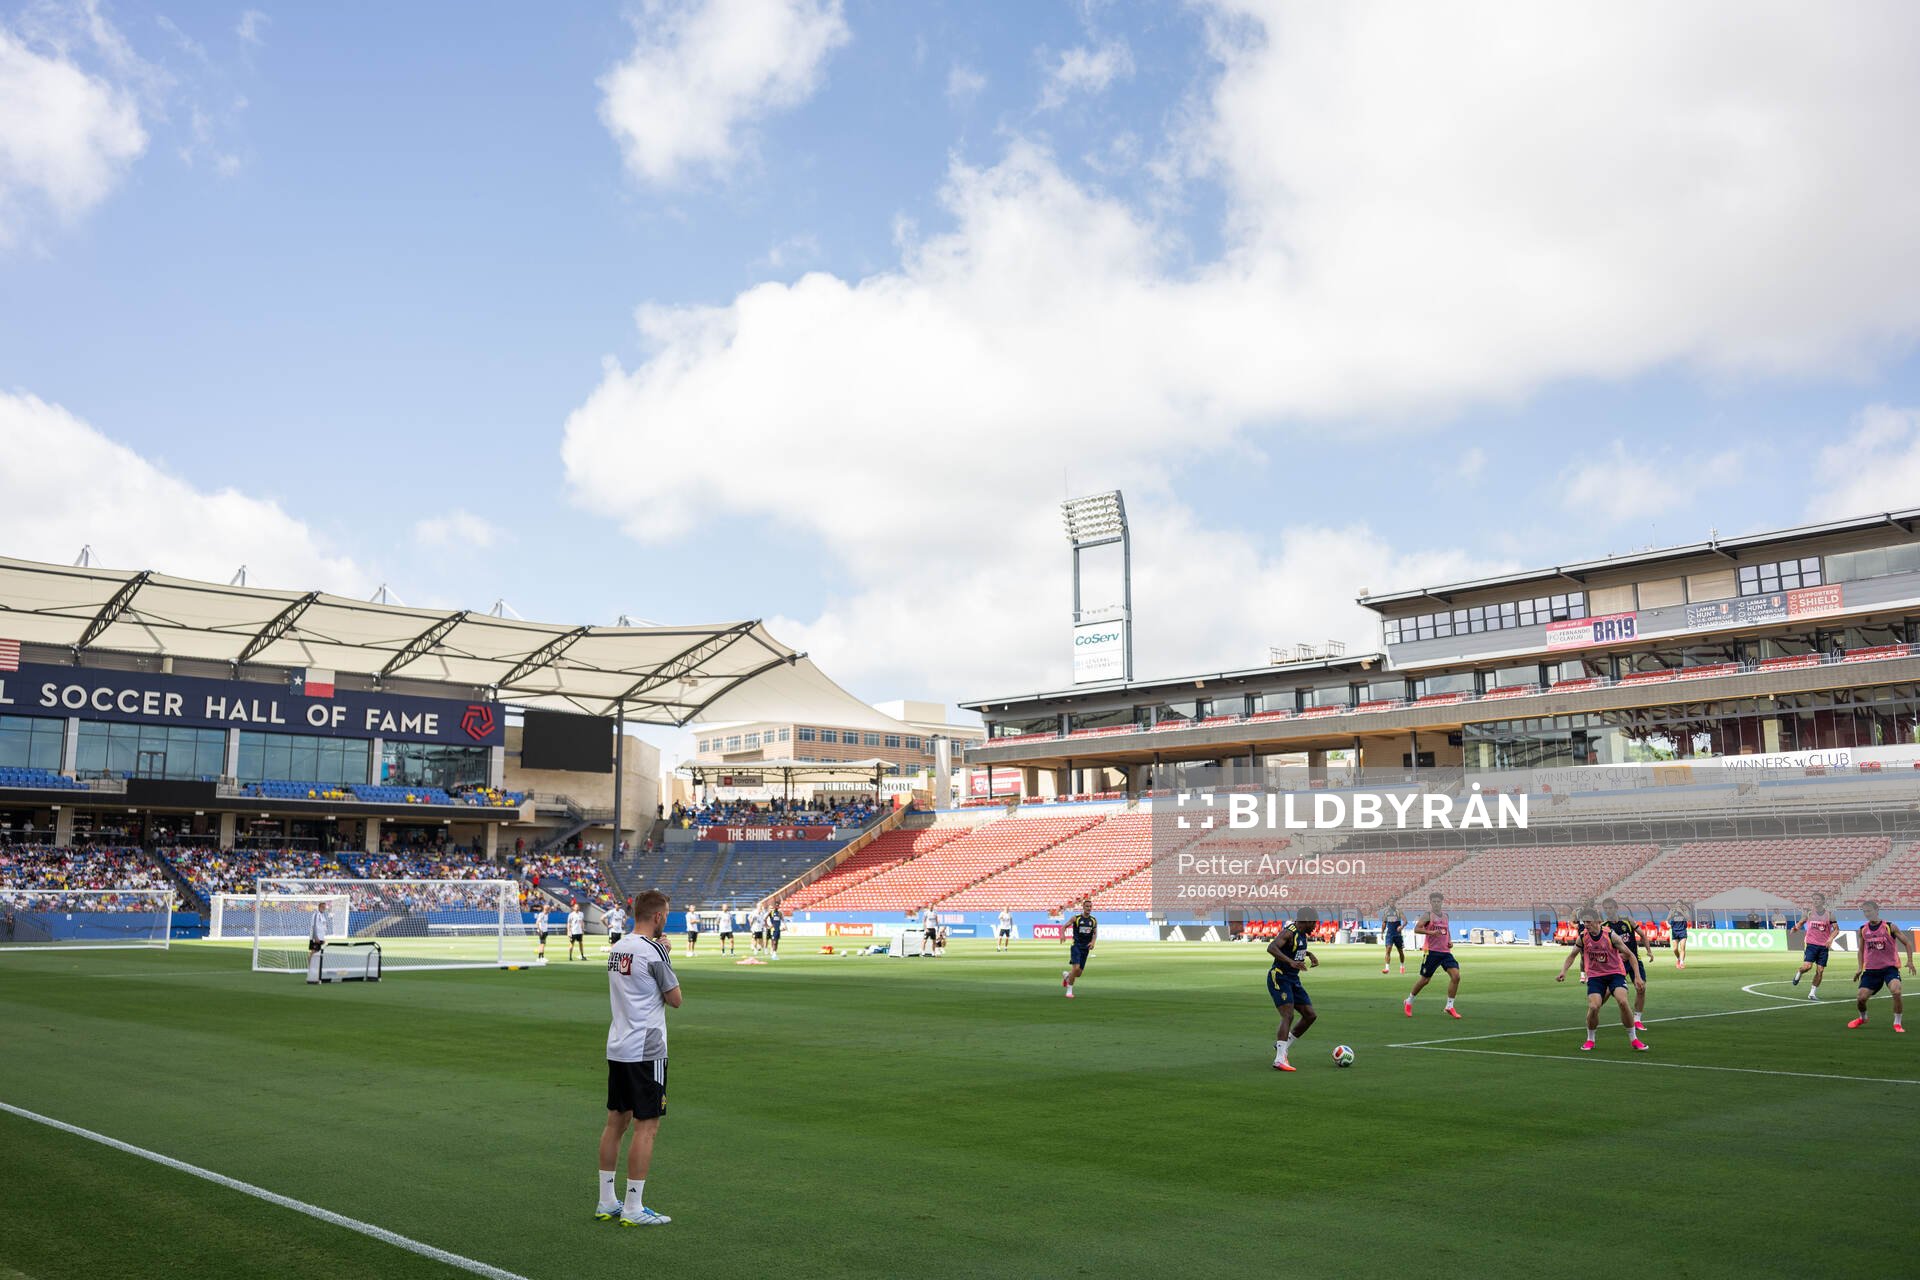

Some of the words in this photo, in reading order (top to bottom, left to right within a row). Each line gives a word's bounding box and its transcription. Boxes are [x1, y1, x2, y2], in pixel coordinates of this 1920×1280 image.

[1747, 603, 1767, 611] HUNT
[1799, 595, 1839, 607] SHIELD
[1696, 610, 1715, 618] HUNT
[1592, 617, 1635, 643] BR19
[1075, 632, 1120, 647] CoServ
[39, 682, 184, 718] SOCCER
[205, 695, 286, 724] HALL
[306, 704, 347, 728] OF
[365, 708, 439, 735] FAME
[1725, 756, 1791, 772] WINNERS
[1809, 752, 1850, 767] CLUB
[1535, 769, 1591, 783] WINNERS
[1605, 767, 1641, 780] CLUB
[883, 782, 914, 791] MORE
[727, 828, 744, 841] THE
[745, 828, 773, 841] RHINE
[990, 924, 1020, 939] VA
[1034, 927, 1060, 937] QATAR
[1686, 931, 1774, 949] aramco
